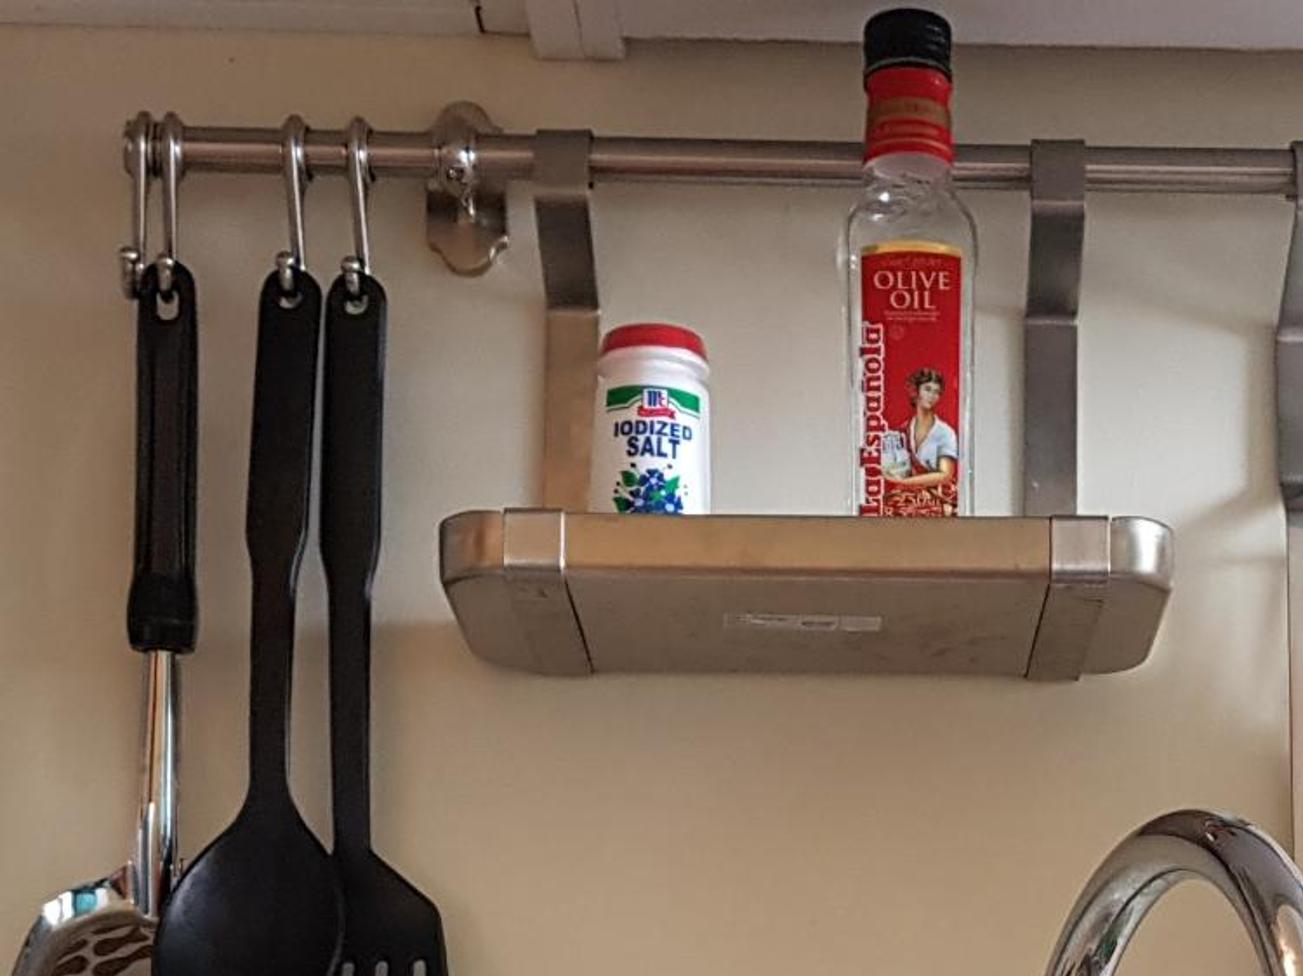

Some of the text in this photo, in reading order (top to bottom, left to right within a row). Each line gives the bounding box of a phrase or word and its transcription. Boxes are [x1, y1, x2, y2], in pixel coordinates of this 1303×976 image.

[873, 270, 950, 290] OLIVE
[890, 289, 936, 309] OIL
[859, 325, 886, 468] Española
[613, 420, 693, 440] IODIZED
[626, 436, 680, 459] SALT
